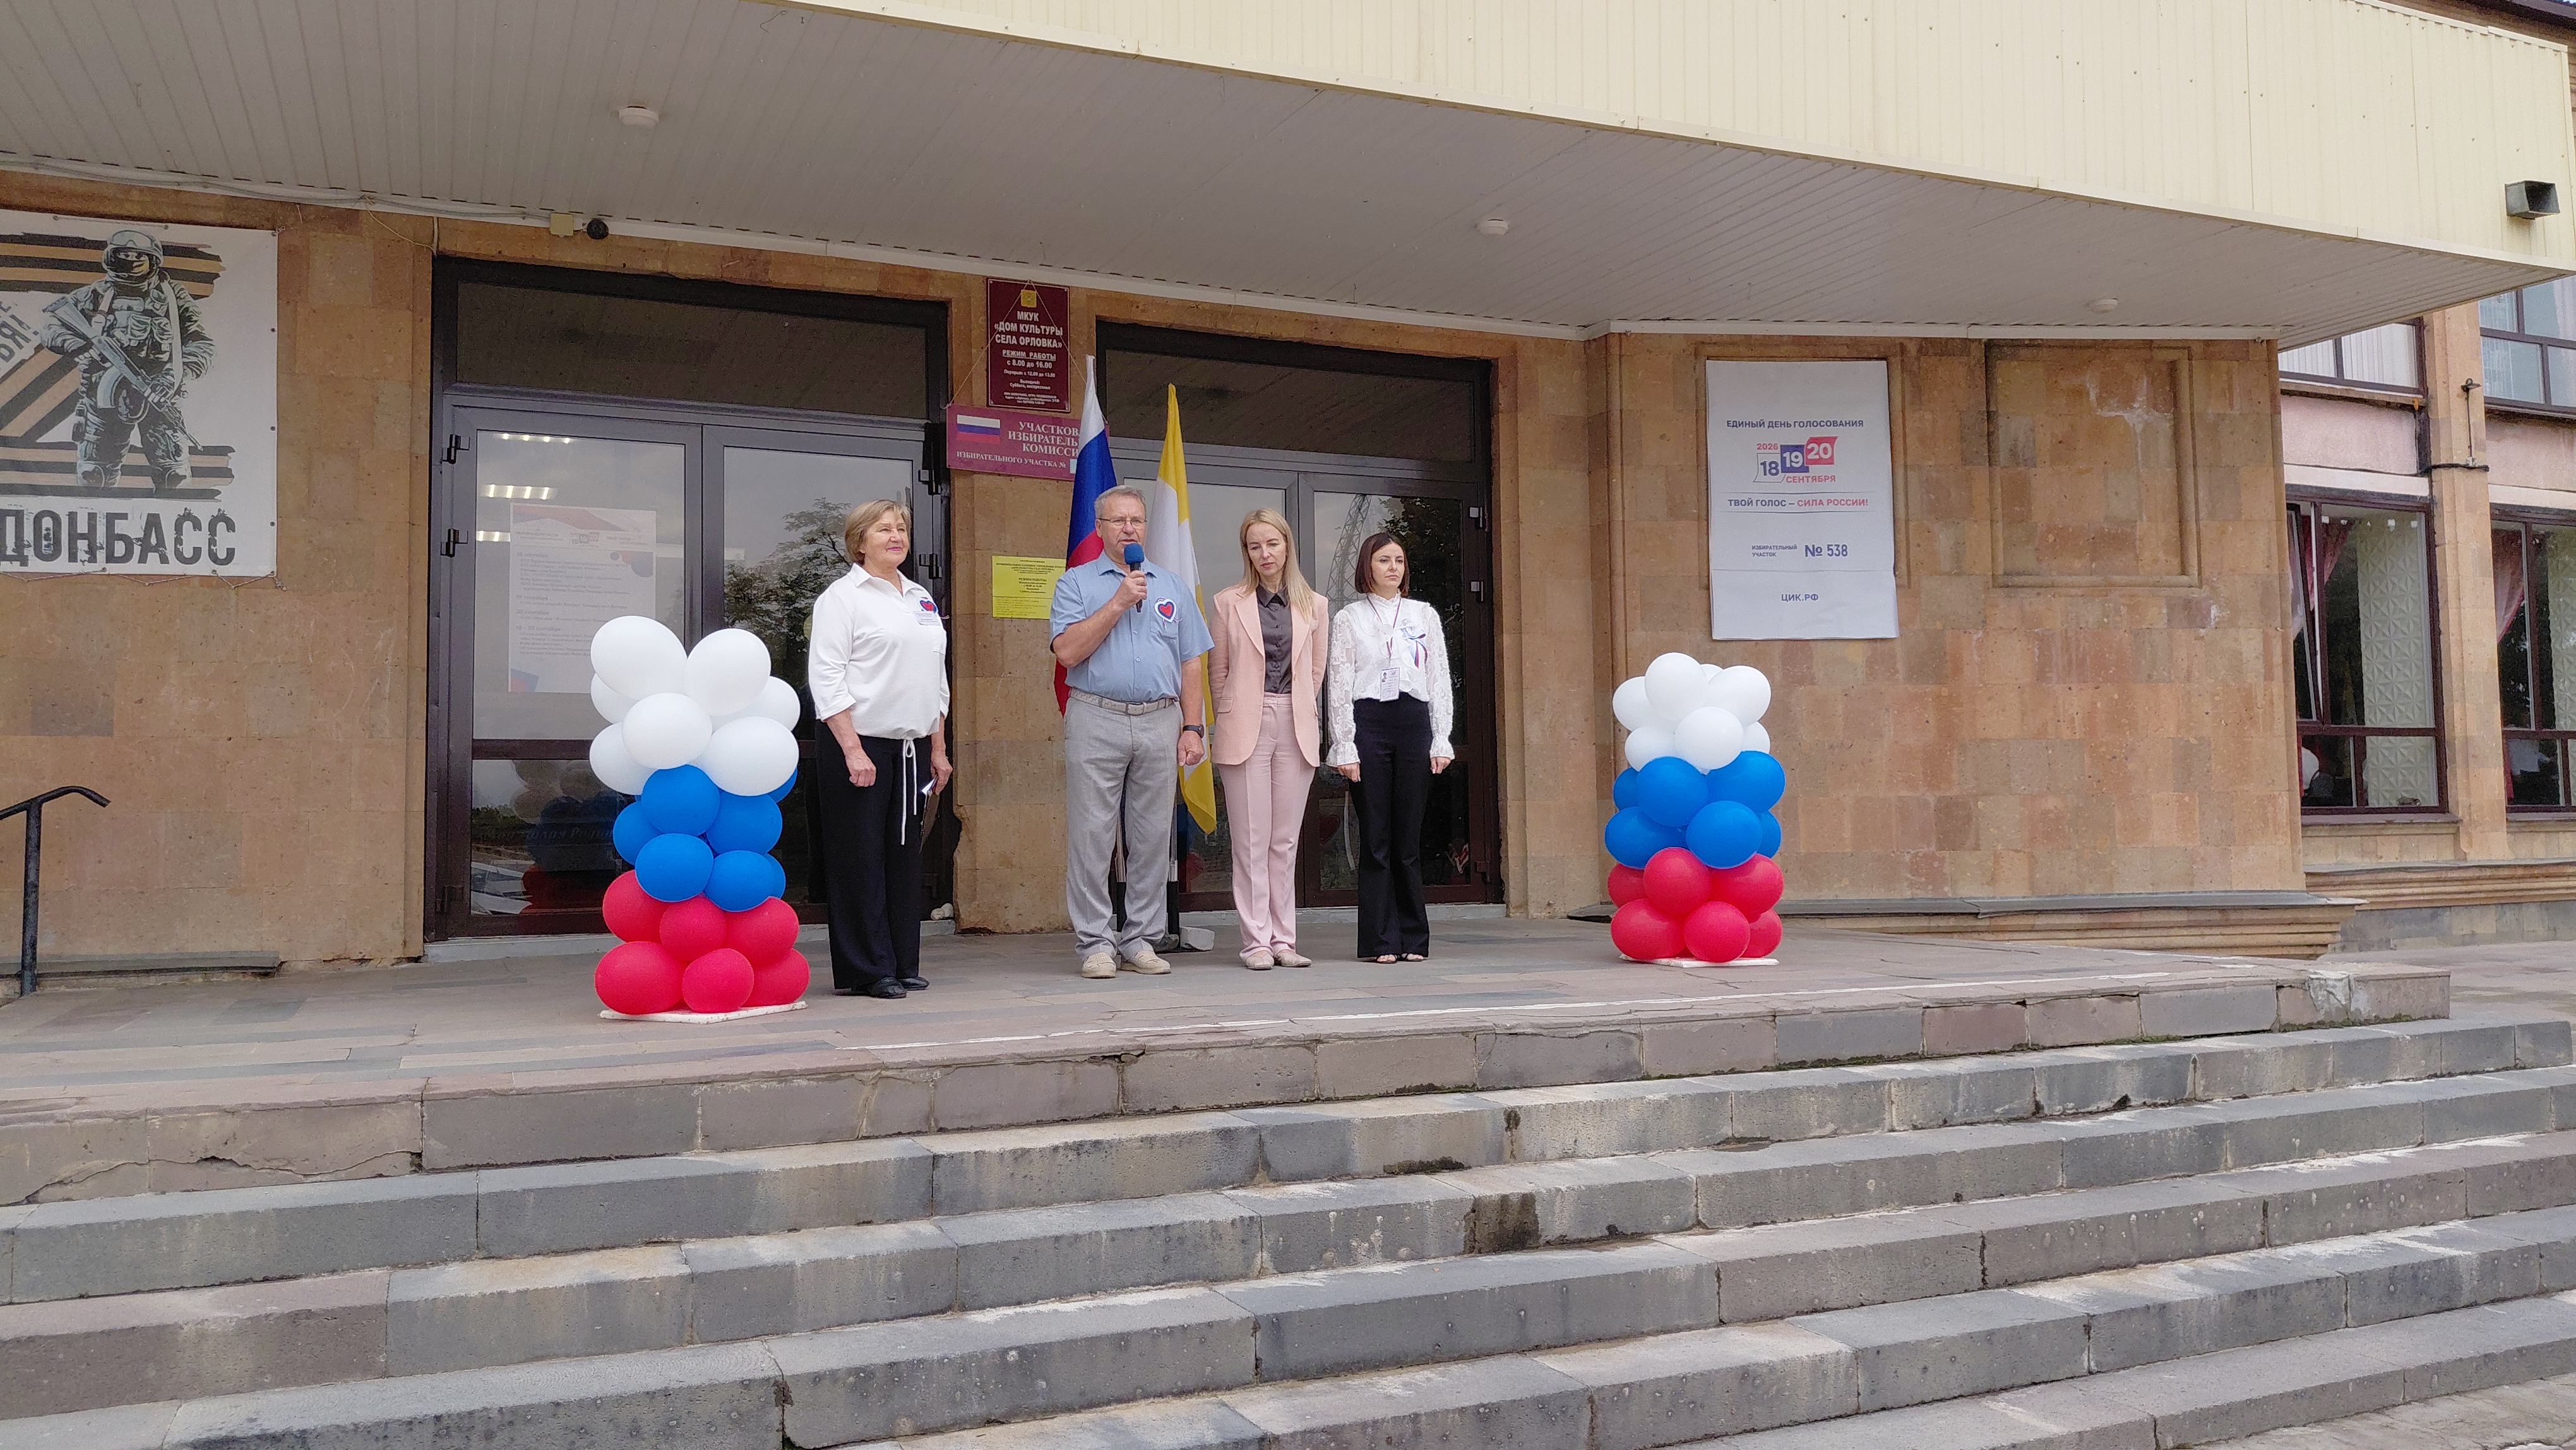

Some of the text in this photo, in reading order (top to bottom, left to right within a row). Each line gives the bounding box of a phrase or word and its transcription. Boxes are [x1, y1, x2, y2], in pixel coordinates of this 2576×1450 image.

[1017, 311, 1039, 321] МКУК
[994, 321, 1063, 336] «ДОМ КУЛЬТУРЫ
[995, 334, 1063, 348] СЕЛА ОРЛОВКА»
[1002, 349, 1056, 360] РЕЖИМ РАБОТЫ
[1018, 421, 1081, 436] УЧАСТКОВ
[1727, 419, 1864, 429] ЕДИНЫЙ ДЕНЬ ГОЛОСОВАНИЯ
[1008, 431, 1078, 446] ИЗБИРАТЕЛЬ
[1807, 443, 1832, 460] 20
[957, 451, 1023, 464] ИЗБИРАТЕЛЬНОГО
[1023, 458, 1058, 468] УЧАСТКА
[1782, 451, 1803, 468] 19
[1760, 460, 1780, 477] 18
[1786, 475, 1836, 484] СЕНТЯБРЯ
[1728, 497, 1753, 506] ТВОЙ
[1756, 499, 1787, 507] ГОЛОС
[1797, 499, 1825, 507] СИЛА
[1827, 498, 1868, 506] РОССИИ!
[0, 507, 236, 567] ДОНБАСС
[1804, 544, 1823, 558] №
[1827, 544, 1848, 557] 538
[1781, 593, 1819, 602] ЦИК.РФ
